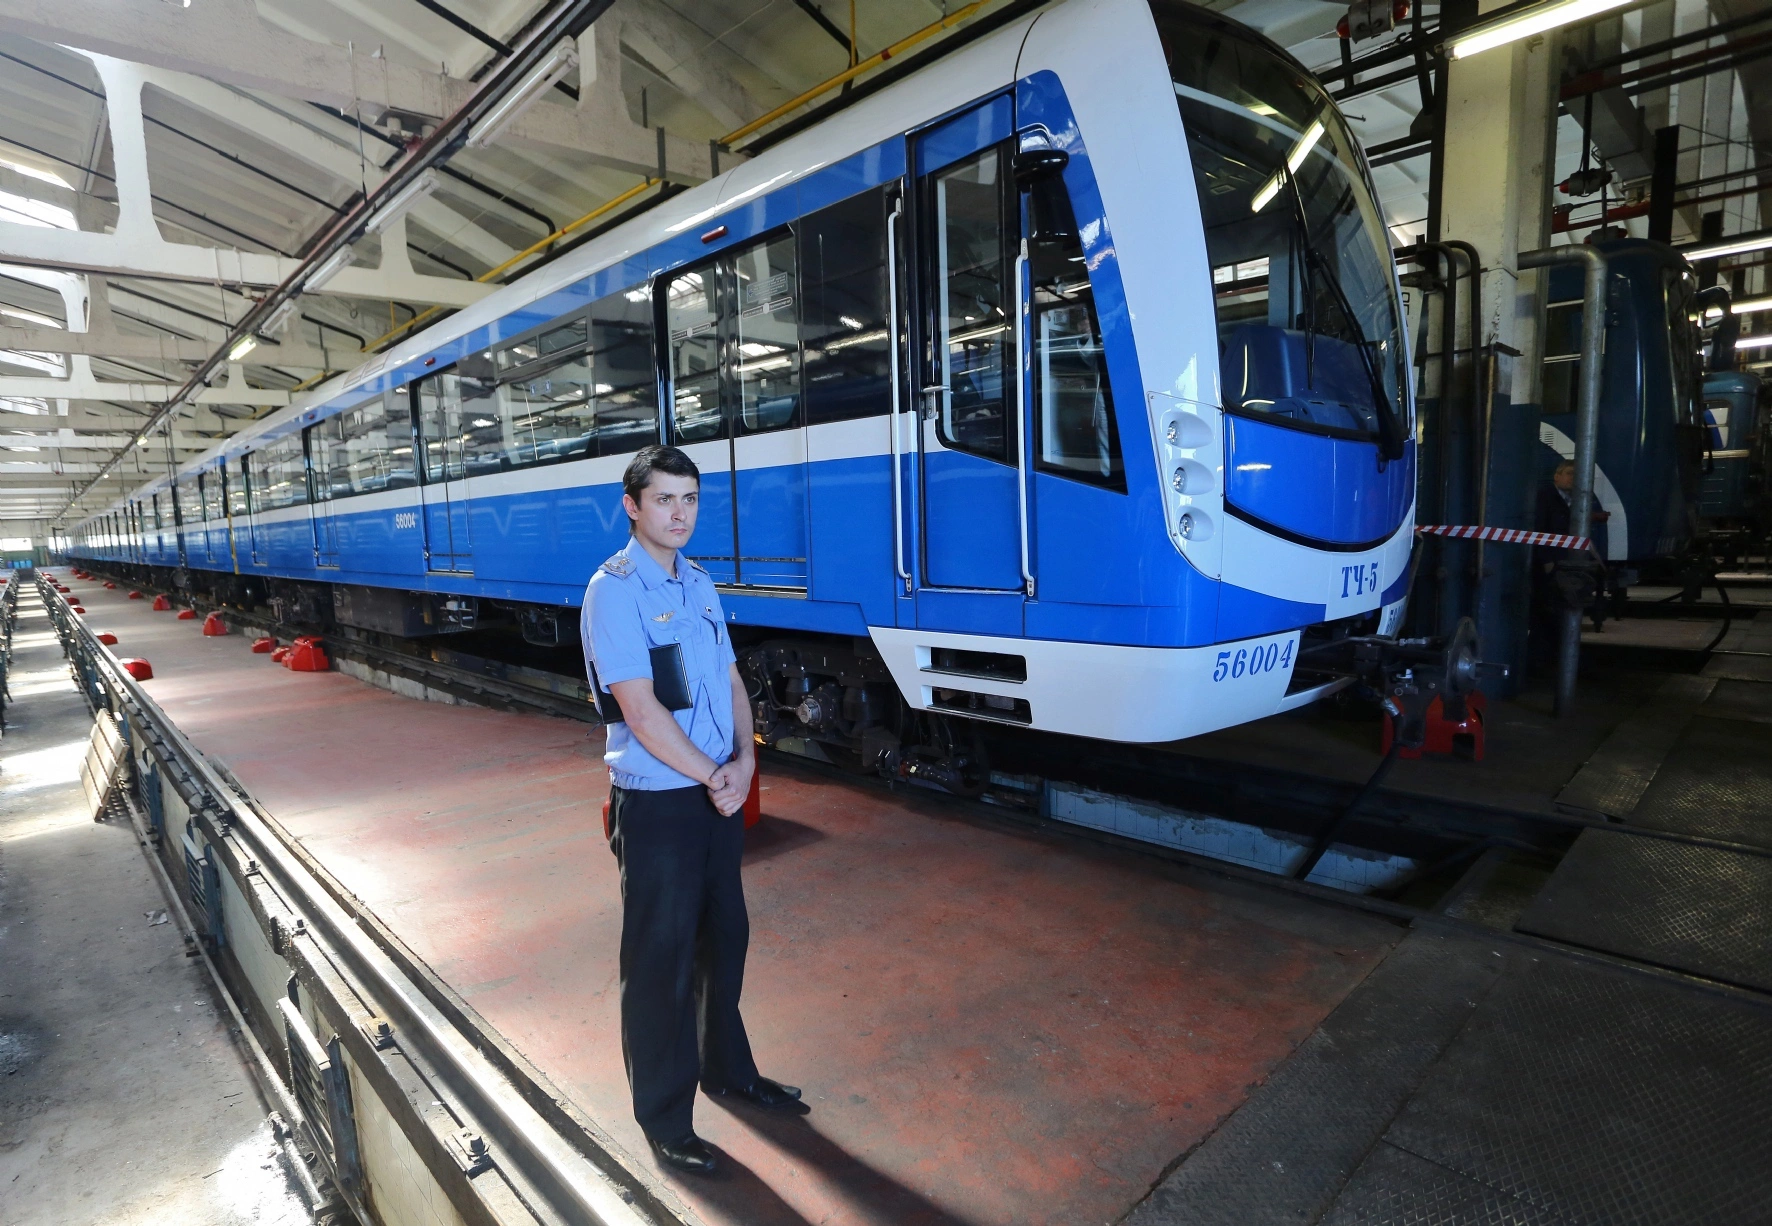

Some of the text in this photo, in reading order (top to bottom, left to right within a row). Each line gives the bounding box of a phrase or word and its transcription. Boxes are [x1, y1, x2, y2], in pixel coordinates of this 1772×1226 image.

[396, 512, 416, 529] 56004
[1341, 561, 1379, 599] ТЧ-5
[1213, 639, 1295, 682] 56004
